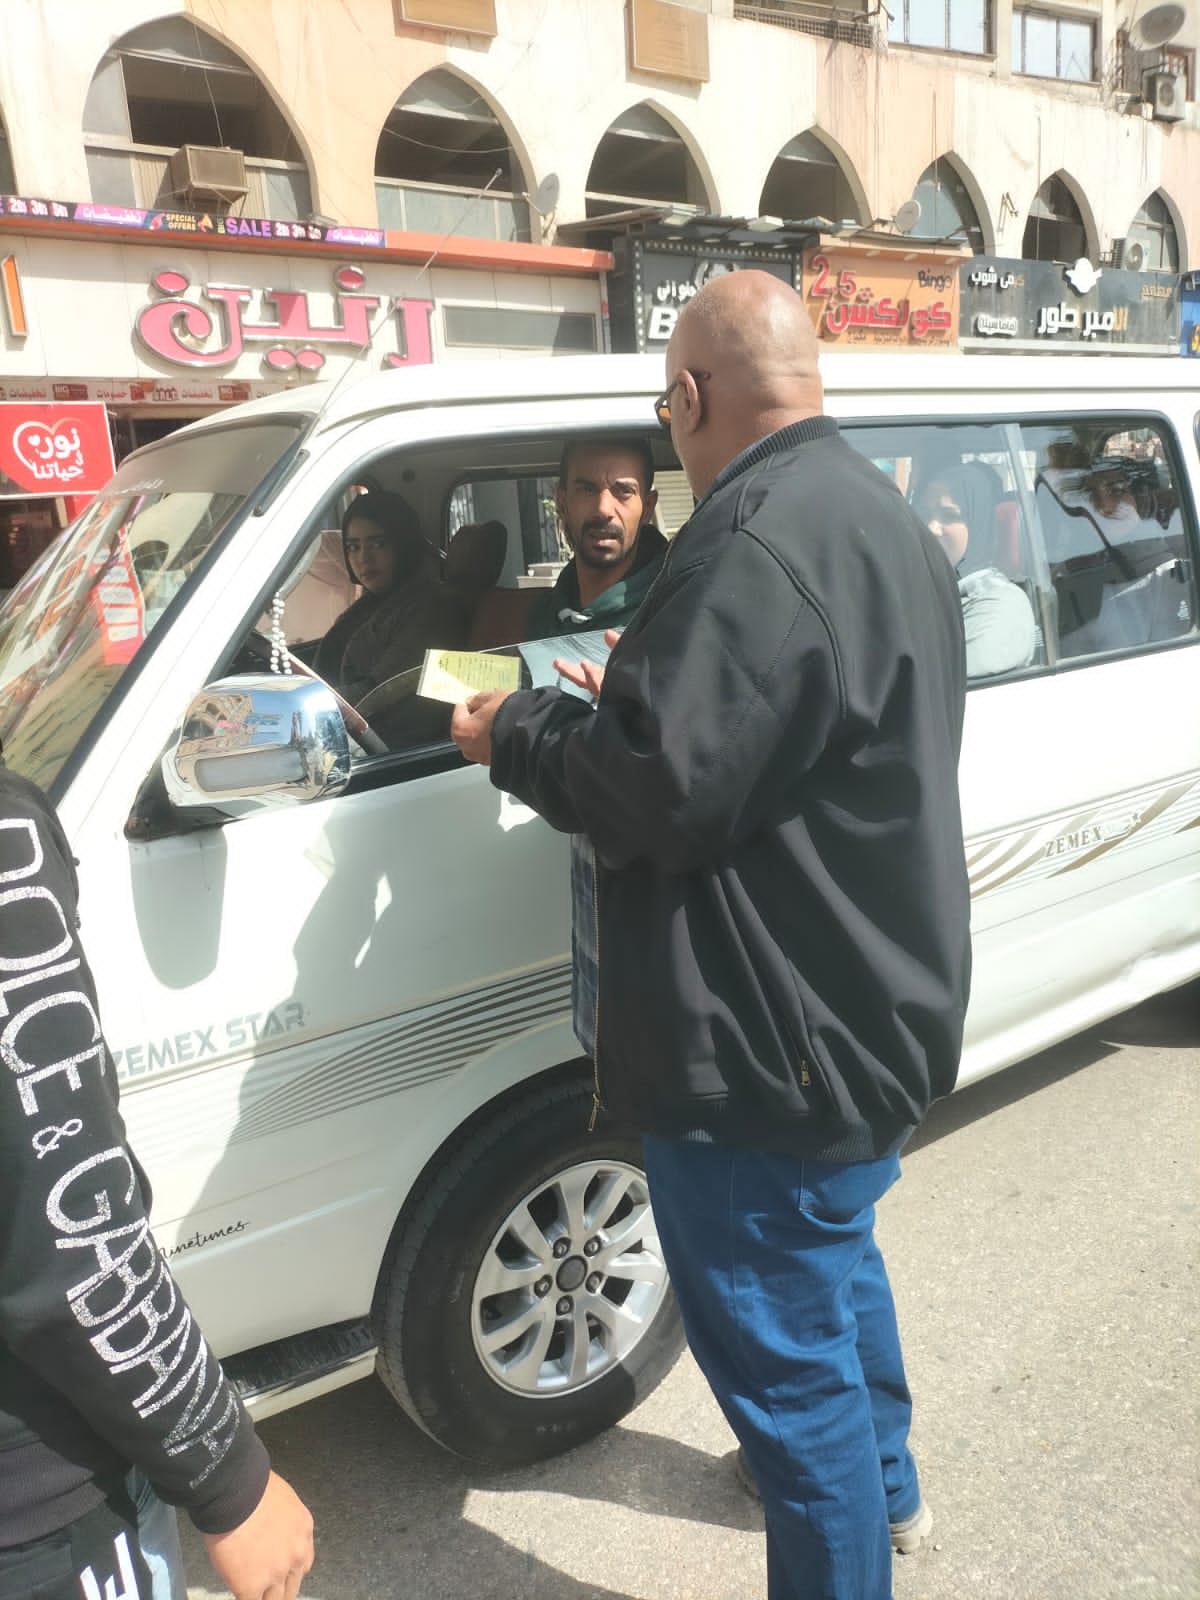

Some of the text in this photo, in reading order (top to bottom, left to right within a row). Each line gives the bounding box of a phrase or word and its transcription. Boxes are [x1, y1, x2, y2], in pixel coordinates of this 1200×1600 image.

[166, 213, 196, 223] SPECIAL
[168, 222, 197, 232] OFFERS
[225, 217, 272, 237] SALE
[917, 269, 953, 293] Bingo
[134, 264, 436, 369] رنين
[1045, 824, 1102, 859] ZEMEX
[110, 1002, 305, 1079] ZEMEX STAR
[32, 1118, 84, 1159] &
